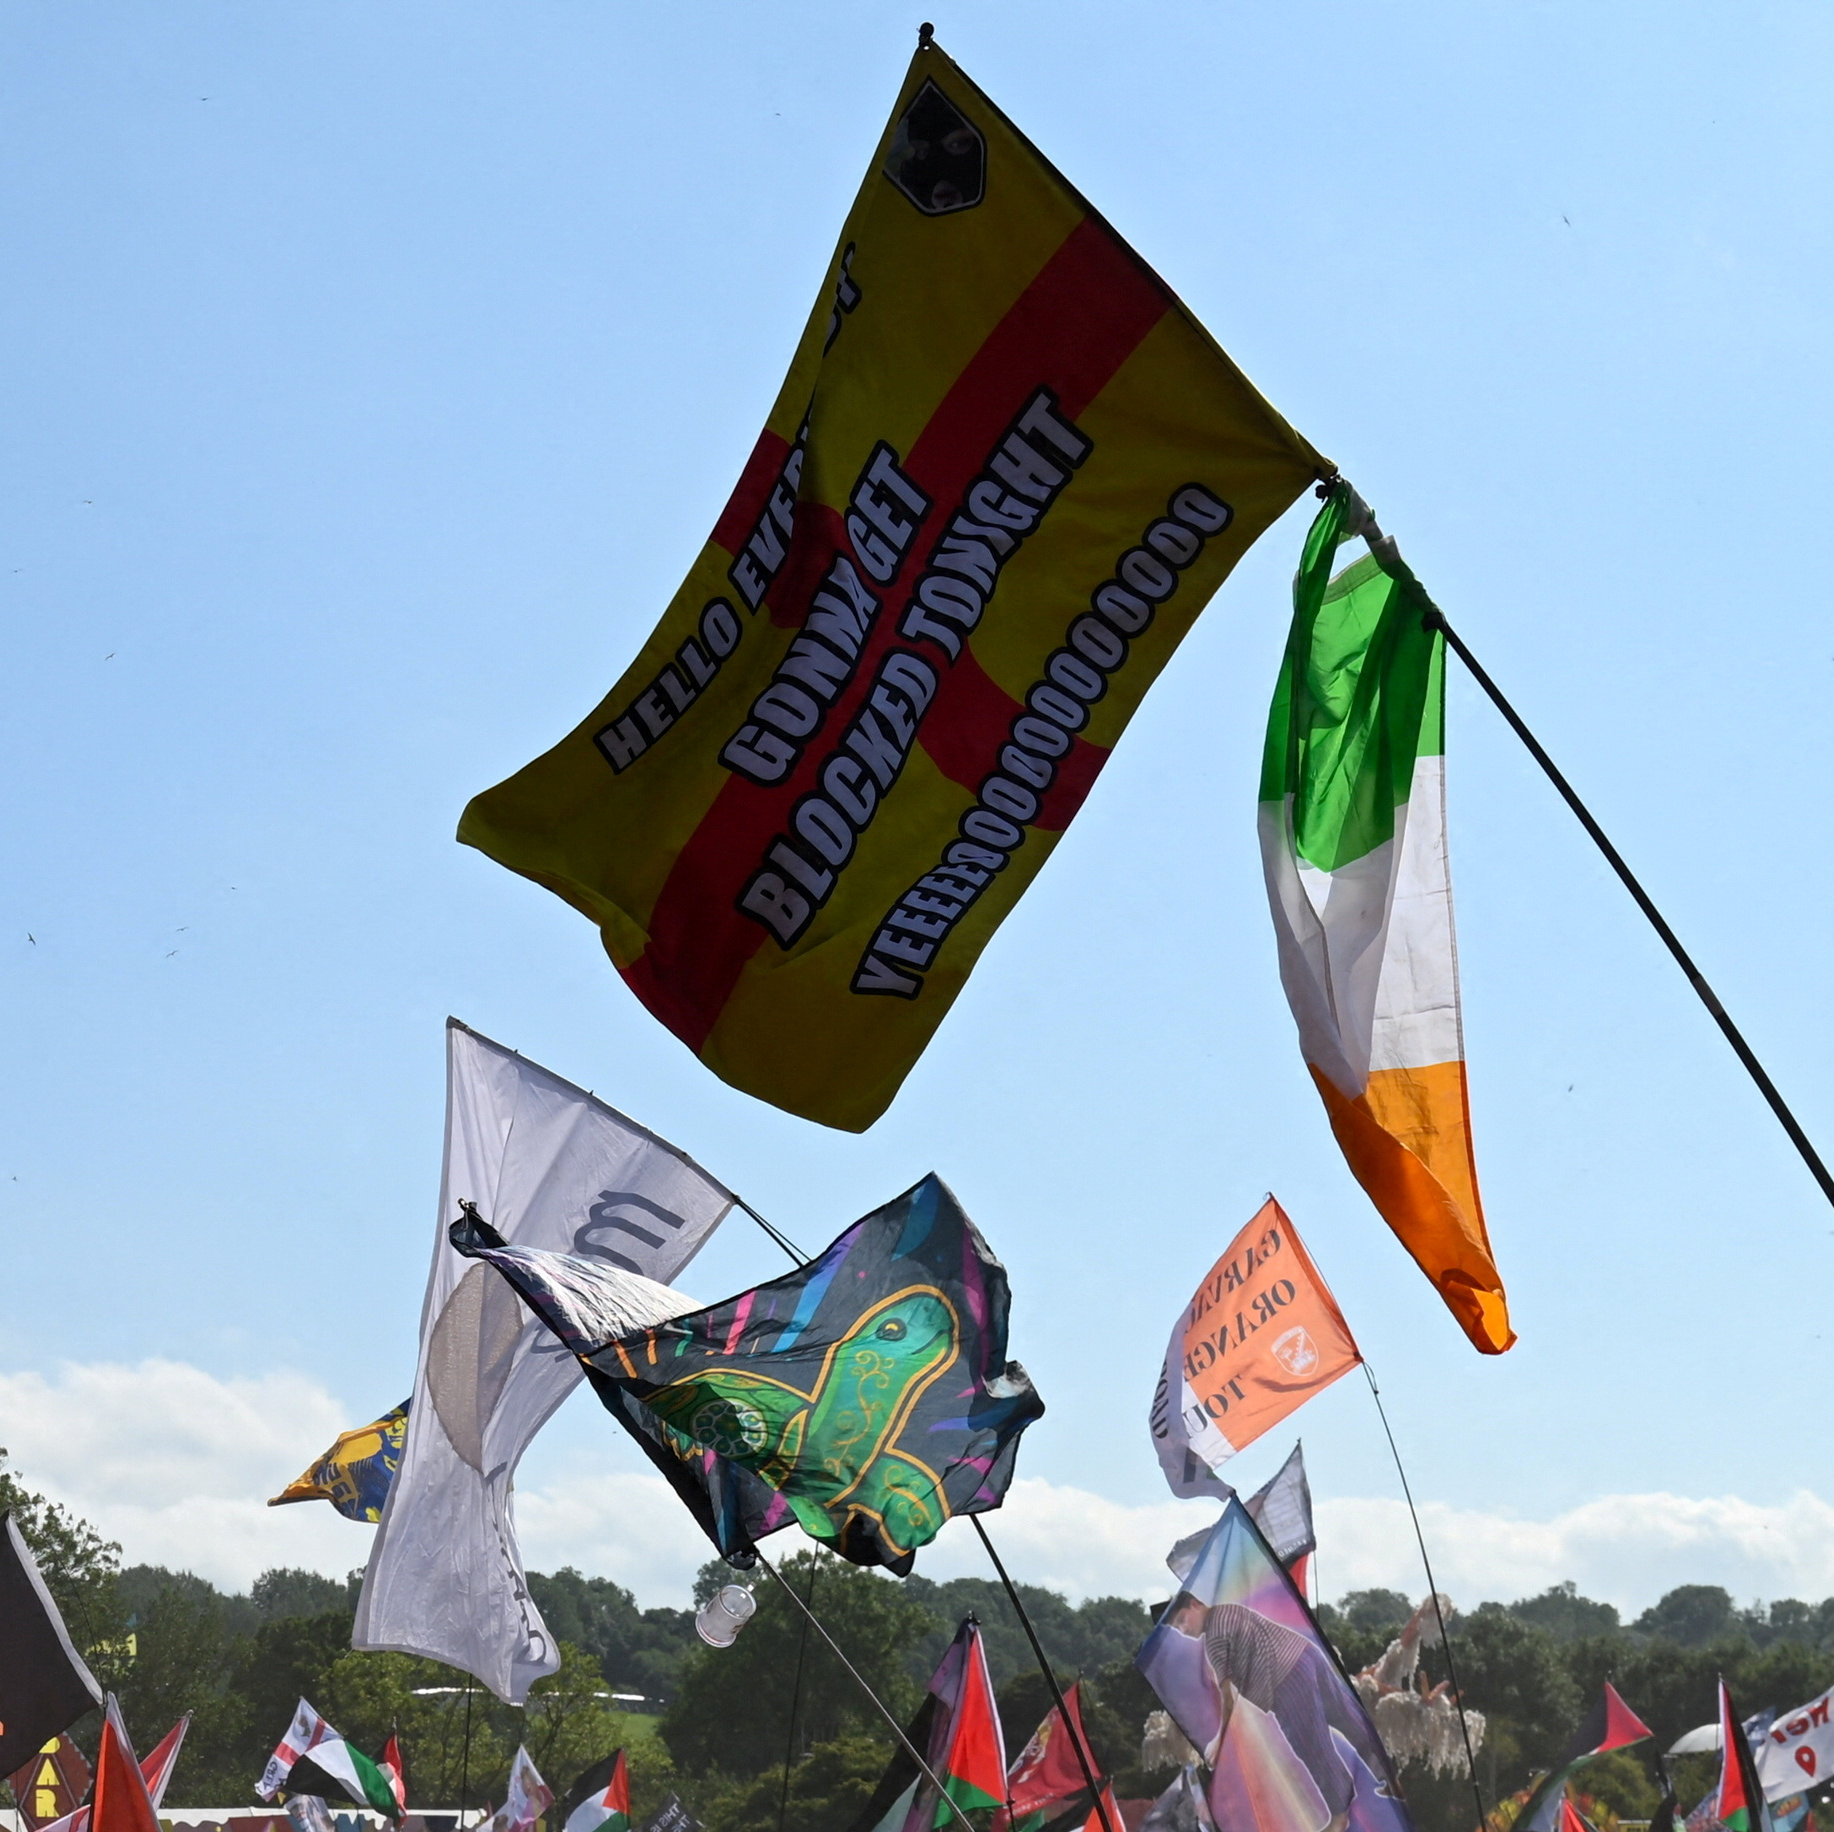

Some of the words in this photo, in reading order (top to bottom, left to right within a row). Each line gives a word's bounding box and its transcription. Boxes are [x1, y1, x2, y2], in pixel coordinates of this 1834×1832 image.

[595, 599, 740, 773] HELLO
[720, 552, 879, 786] GONNA
[845, 441, 932, 586] GET
[736, 648, 938, 949] BLOCKED
[898, 386, 1092, 665] TONIGHT
